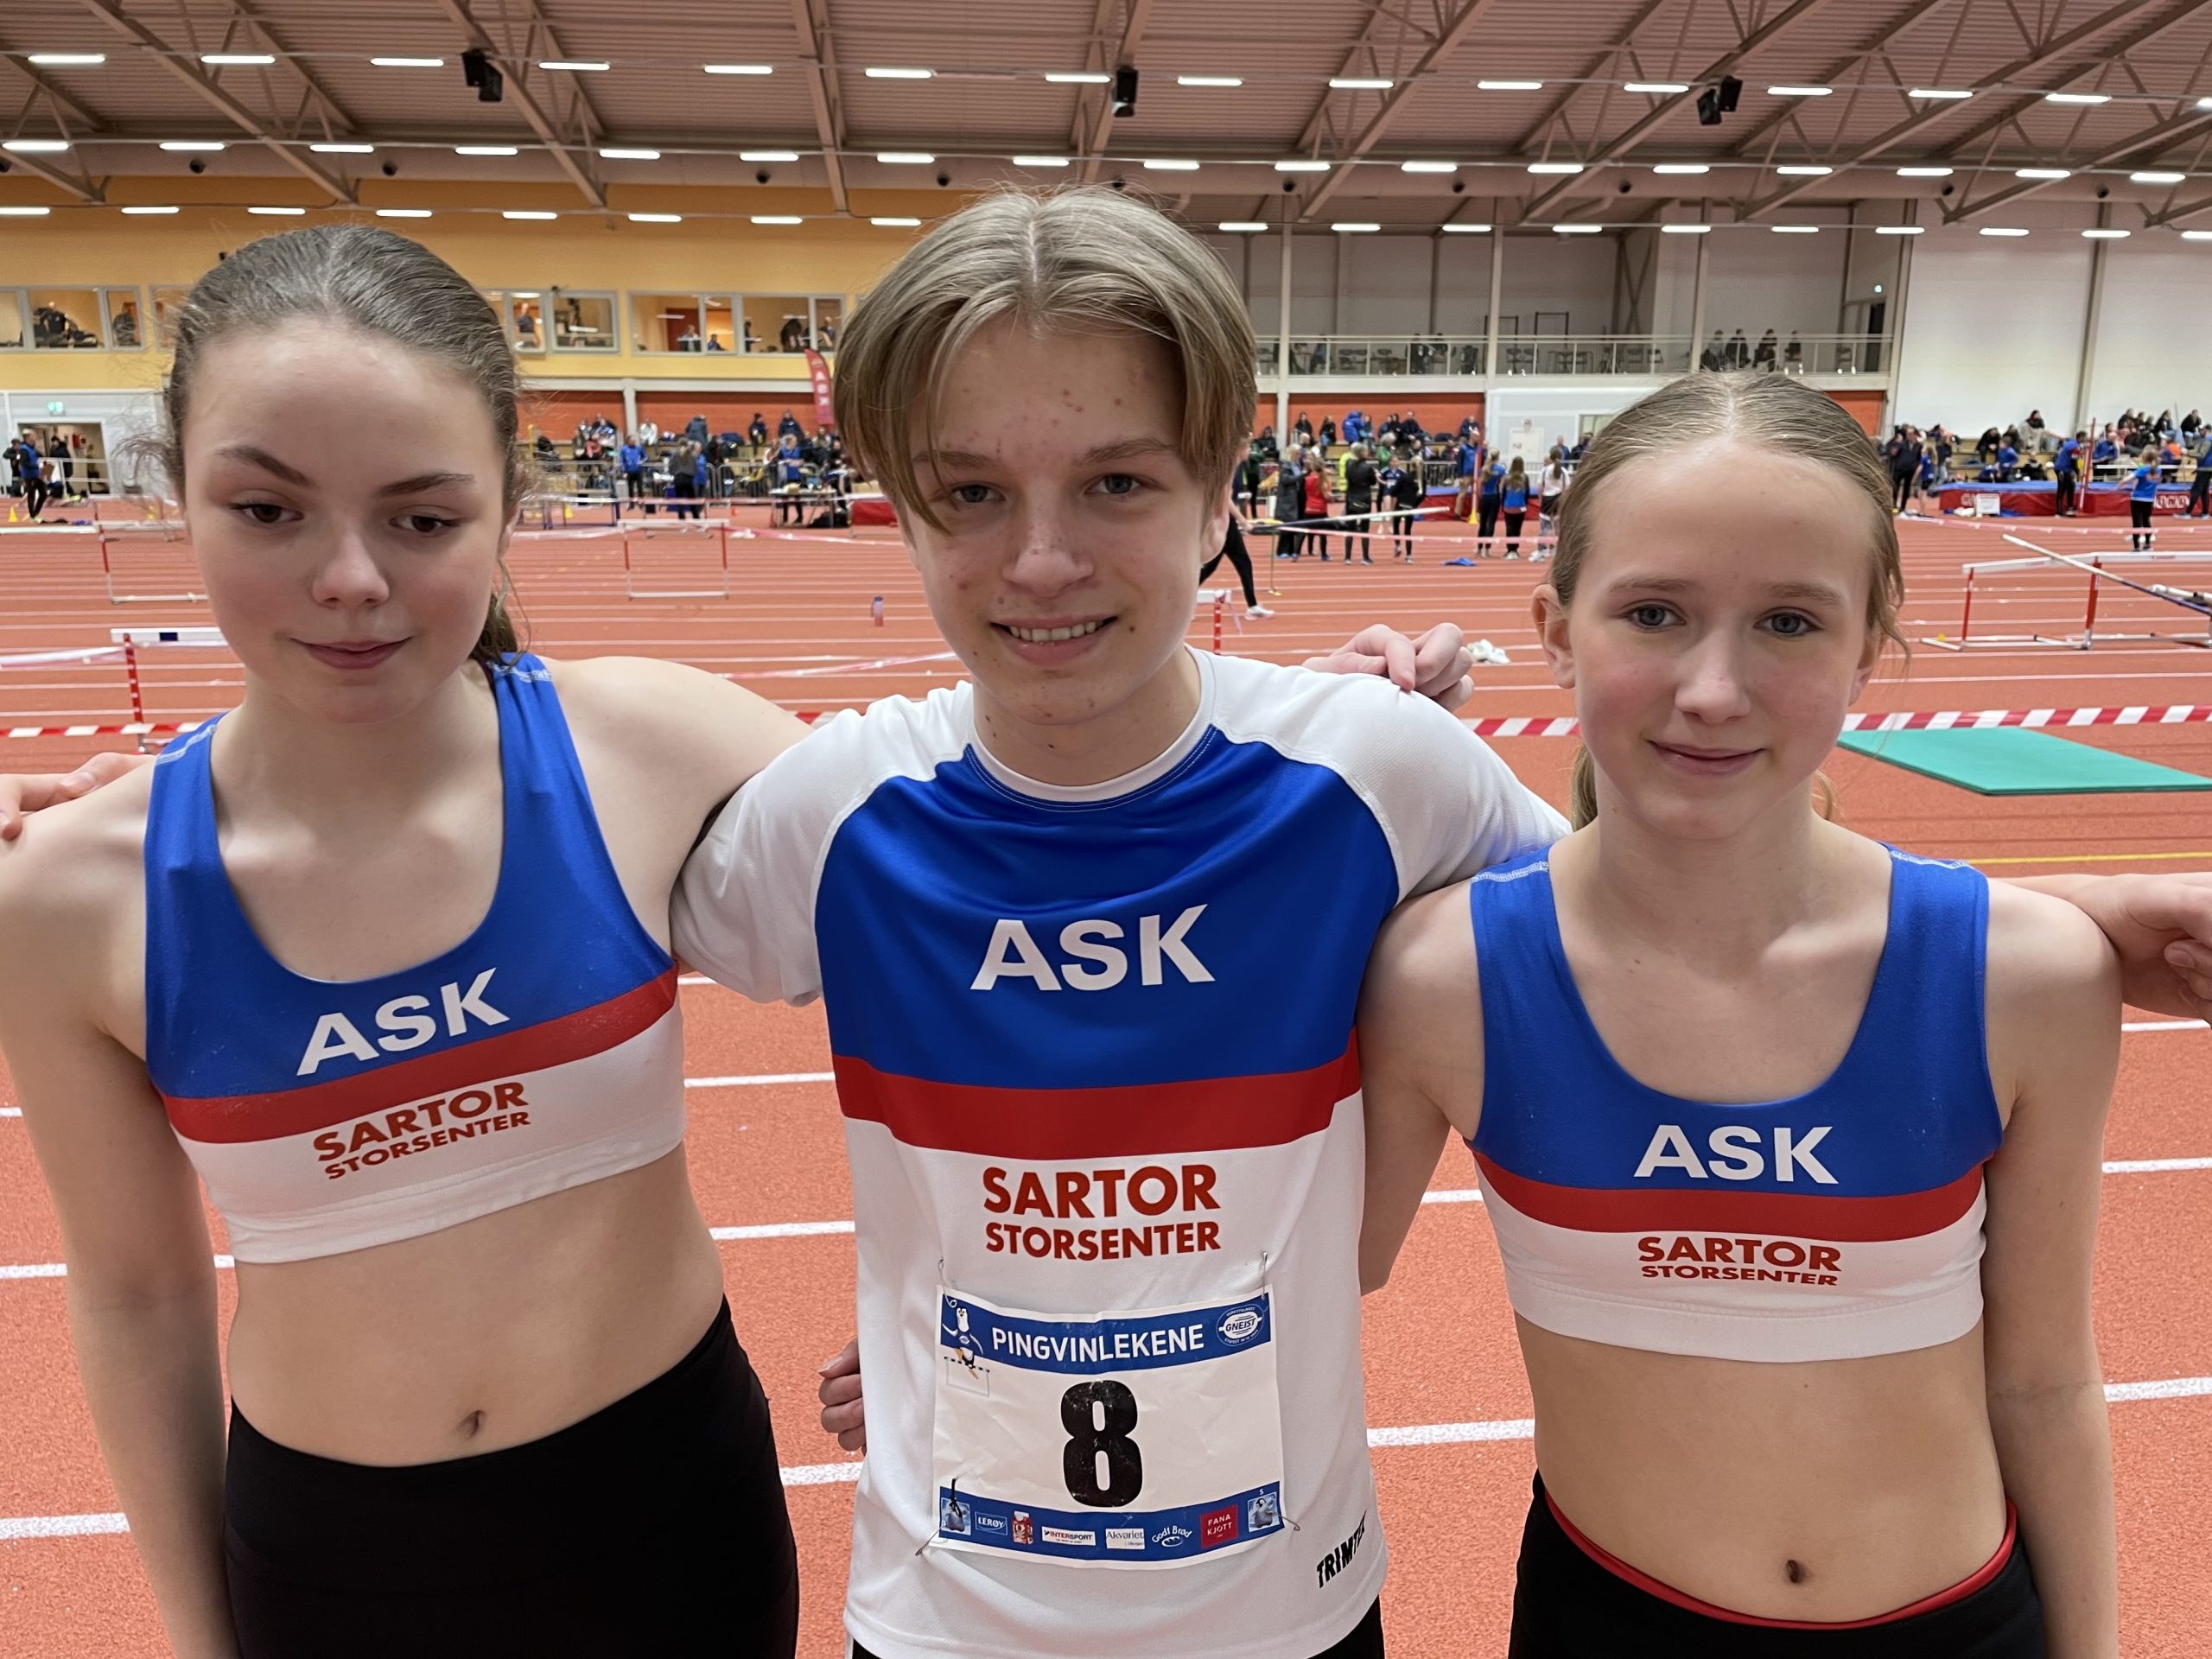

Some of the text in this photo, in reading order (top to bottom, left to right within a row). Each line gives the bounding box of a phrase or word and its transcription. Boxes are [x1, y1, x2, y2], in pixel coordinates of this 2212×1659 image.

[969, 904, 1216, 991] ASK
[296, 967, 511, 1076] ASK
[313, 1082, 529, 1161] SARTOR
[325, 1112, 531, 1179] STORSENTER
[1633, 1124, 1839, 1184] ASK
[982, 1164, 1221, 1218] SARTOR
[985, 1221, 1221, 1261] STORSENTER
[1638, 1236, 1841, 1272] SARTOR
[1641, 1265, 1838, 1286] STORSENTER
[992, 1324, 1205, 1363] PINGVINLEKENE
[1225, 1318, 1256, 1332] GNEIST
[1060, 1379, 1143, 1508] 8
[978, 1516, 1004, 1528] LERØY
[1050, 1530, 1093, 1541] INTERSPORT
[1106, 1530, 1143, 1540] Akvariet
[1208, 1514, 1231, 1526] FANA
